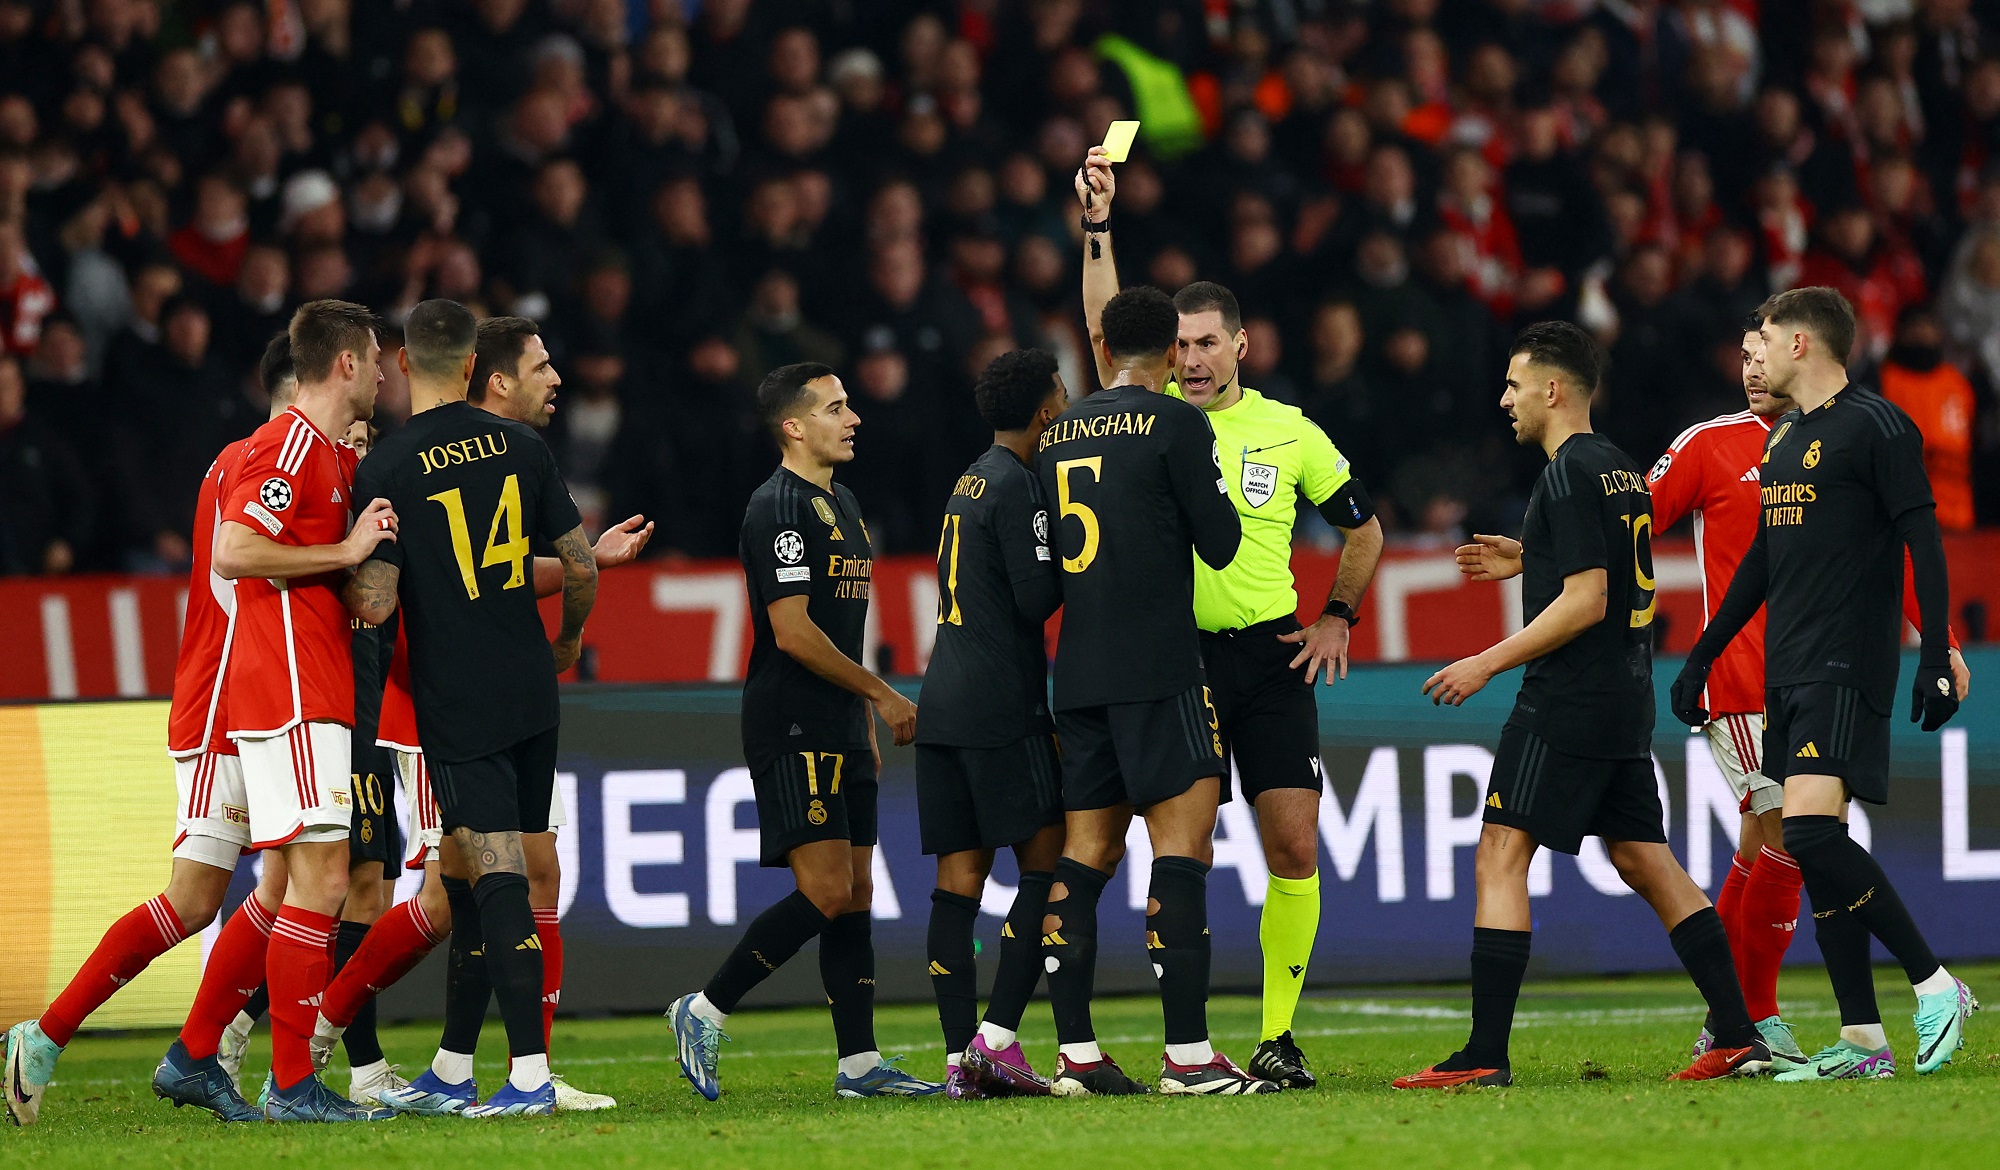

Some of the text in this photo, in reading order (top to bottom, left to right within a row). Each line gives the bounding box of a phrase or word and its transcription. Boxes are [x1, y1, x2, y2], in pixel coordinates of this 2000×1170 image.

[417, 431, 508, 475] JOSELU
[1039, 412, 1156, 453] BELLINGHAM
[1245, 486, 1270, 496] OFFICIAL
[1248, 480, 1269, 489] MATCH
[1249, 468, 1270, 479] UEFA
[1760, 480, 1817, 506] mirates
[1056, 455, 1103, 573] 5
[1772, 506, 1803, 527] BETTER
[426, 473, 530, 600] 14
[835, 580, 871, 600] FLY BETTE
[1202, 685, 1219, 731] 5
[799, 751, 844, 796] 17
[351, 772, 385, 817] 10
